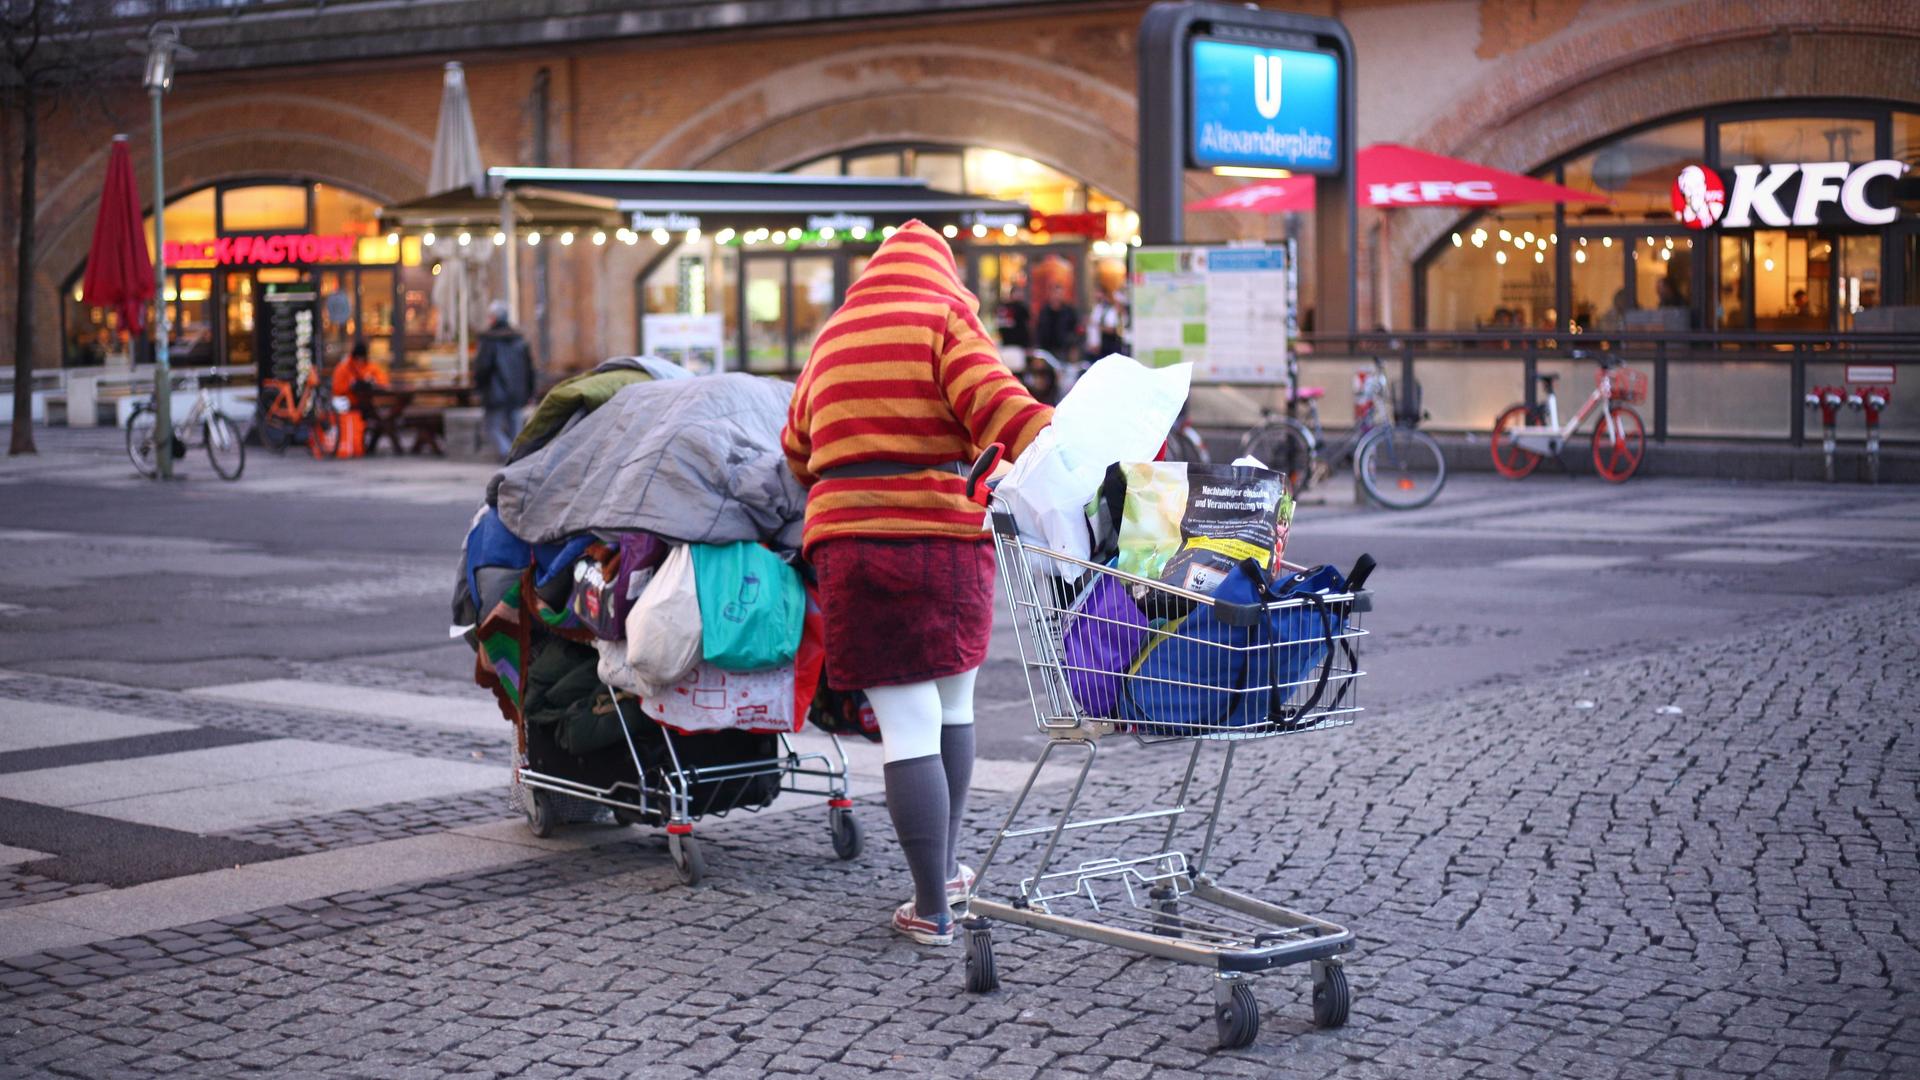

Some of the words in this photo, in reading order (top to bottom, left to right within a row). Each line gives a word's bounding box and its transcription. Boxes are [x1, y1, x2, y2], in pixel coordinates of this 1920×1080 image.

[1254, 54, 1282, 119] U
[1201, 121, 1332, 165] Alexanderplatz
[1368, 181, 1498, 205] KFC
[1722, 160, 1904, 228] KFC
